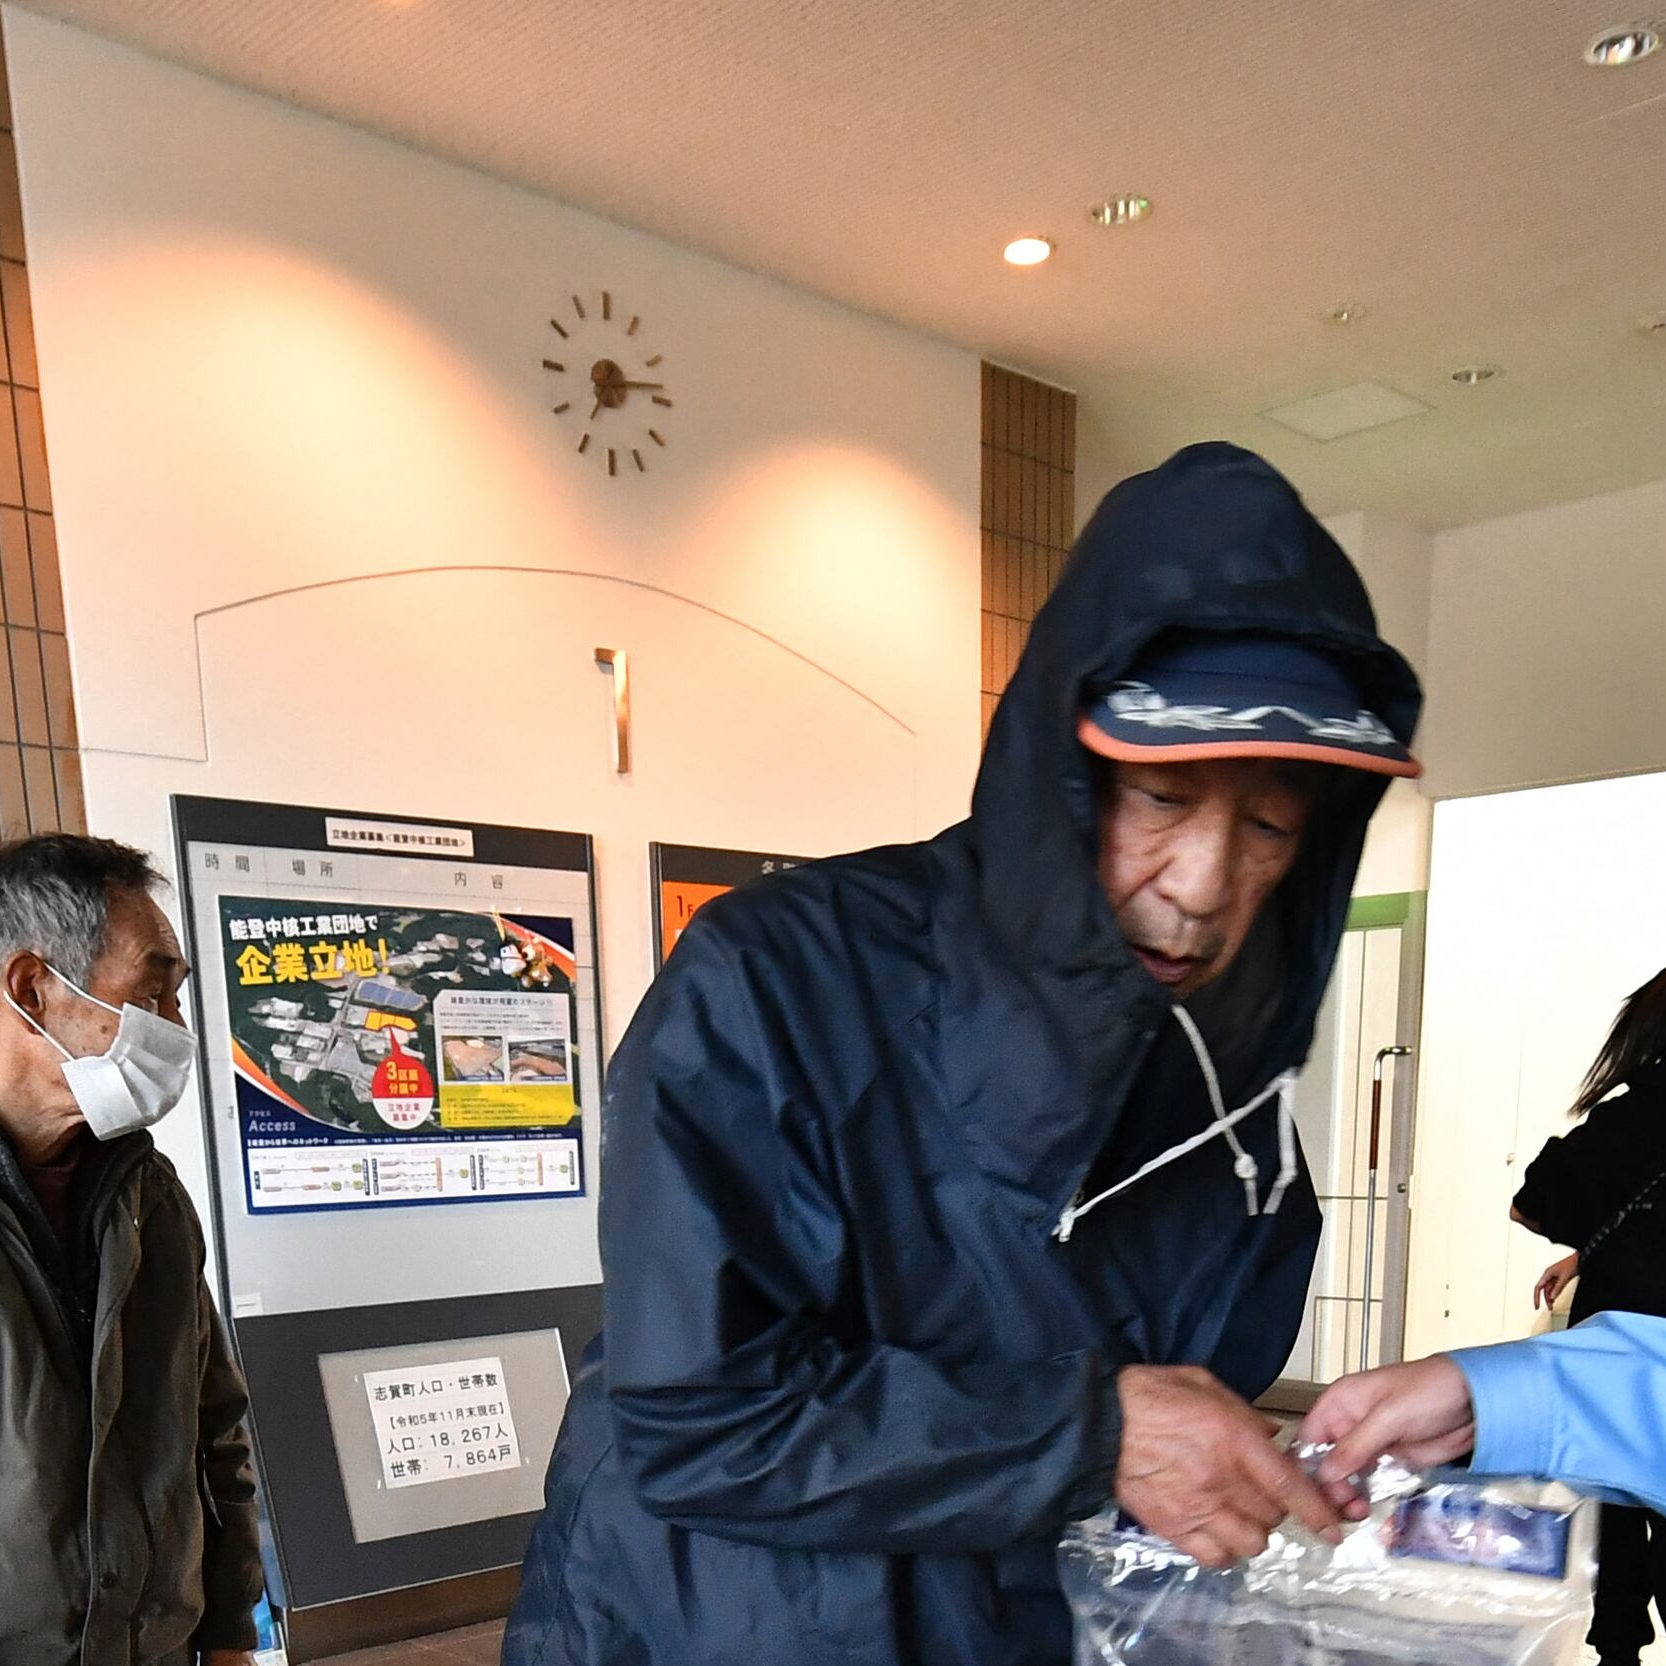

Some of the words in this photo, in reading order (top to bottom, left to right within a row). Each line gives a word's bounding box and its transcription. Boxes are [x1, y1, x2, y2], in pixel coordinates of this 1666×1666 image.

[228, 914, 378, 941] 能登中核工業団地で
[235, 938, 390, 986] 企業立地！
[248, 1119, 297, 1133] Access
[374, 1373, 498, 1401] 志賀町人口・世帯数
[389, 1401, 505, 1430] 【令和5年11月末現在】
